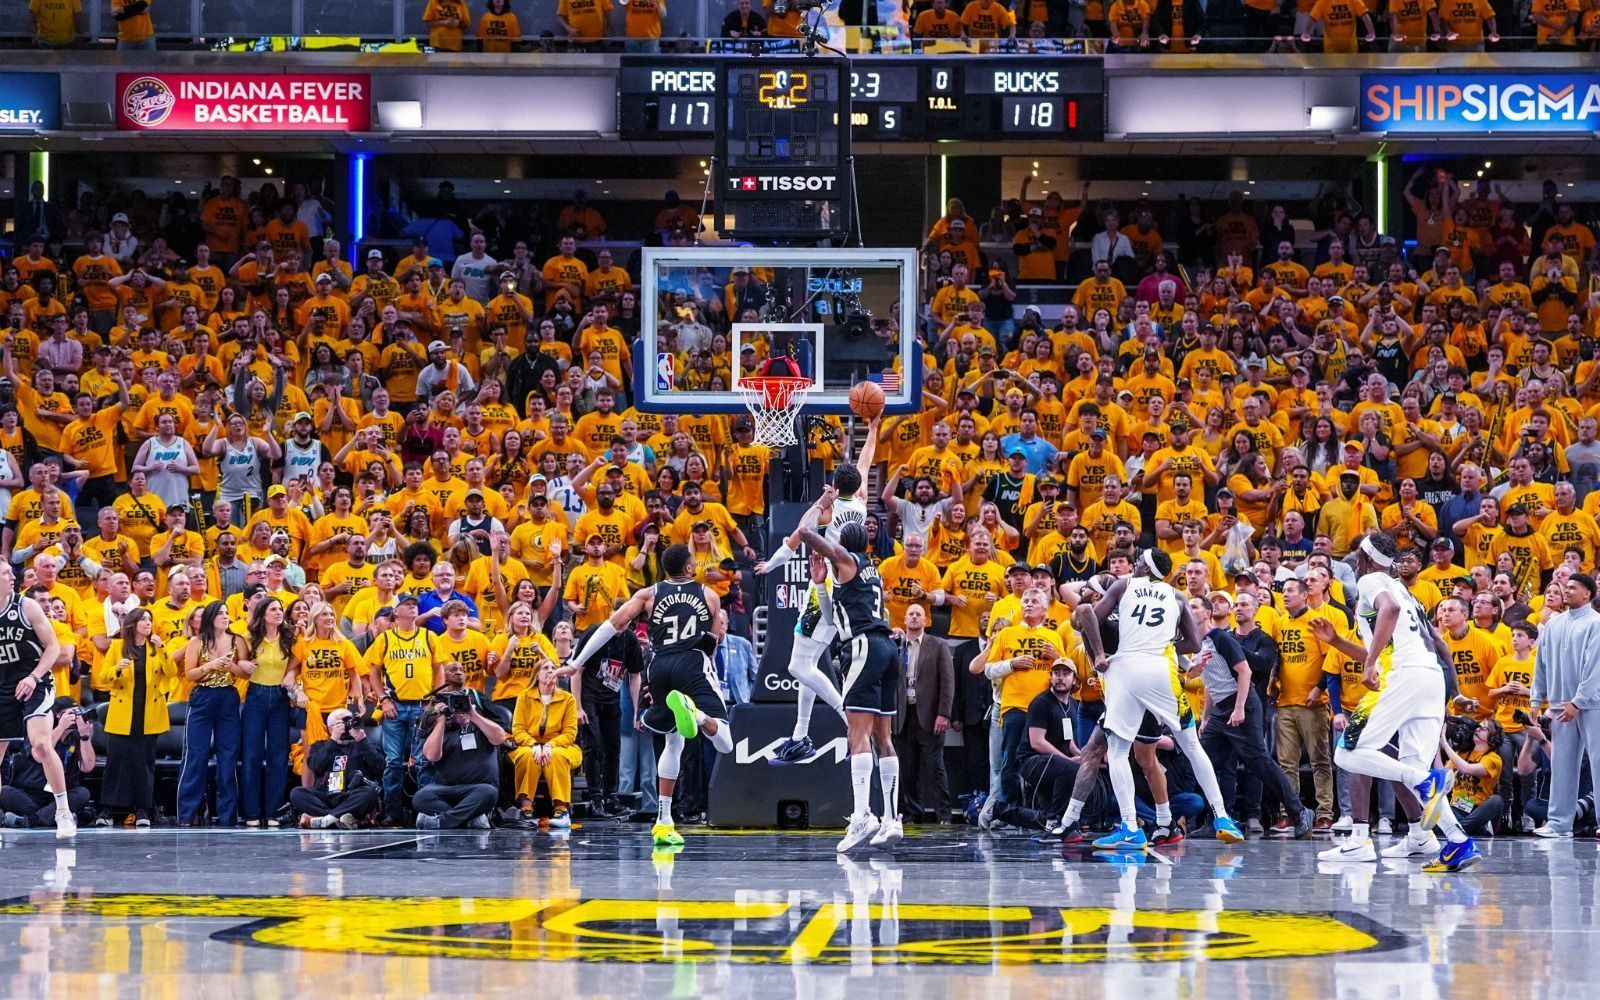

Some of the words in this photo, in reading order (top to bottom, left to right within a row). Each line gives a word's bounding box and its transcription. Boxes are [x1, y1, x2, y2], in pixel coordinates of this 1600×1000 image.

[936, 72, 947, 90] 0
[994, 72, 1059, 92] BUCKS
[180, 82, 285, 100] INDIANA
[290, 82, 363, 100] FEVER
[928, 98, 956, 110] T.O.L.
[194, 104, 348, 123] BASKETBALL
[670, 103, 710, 125] 117
[885, 111, 895, 129] 5
[1014, 103, 1052, 126] 118
[759, 177, 836, 190] TISSOT
[247, 467, 254, 476] 2
[784, 561, 808, 582] THE
[1134, 588, 1166, 601] SIAKAM
[653, 594, 709, 625] ANTETOKOUNMPO
[1131, 605, 1165, 626] 43
[663, 616, 696, 644] 34
[1281, 630, 1300, 640] YES
[390, 648, 426, 660] INDIANA
